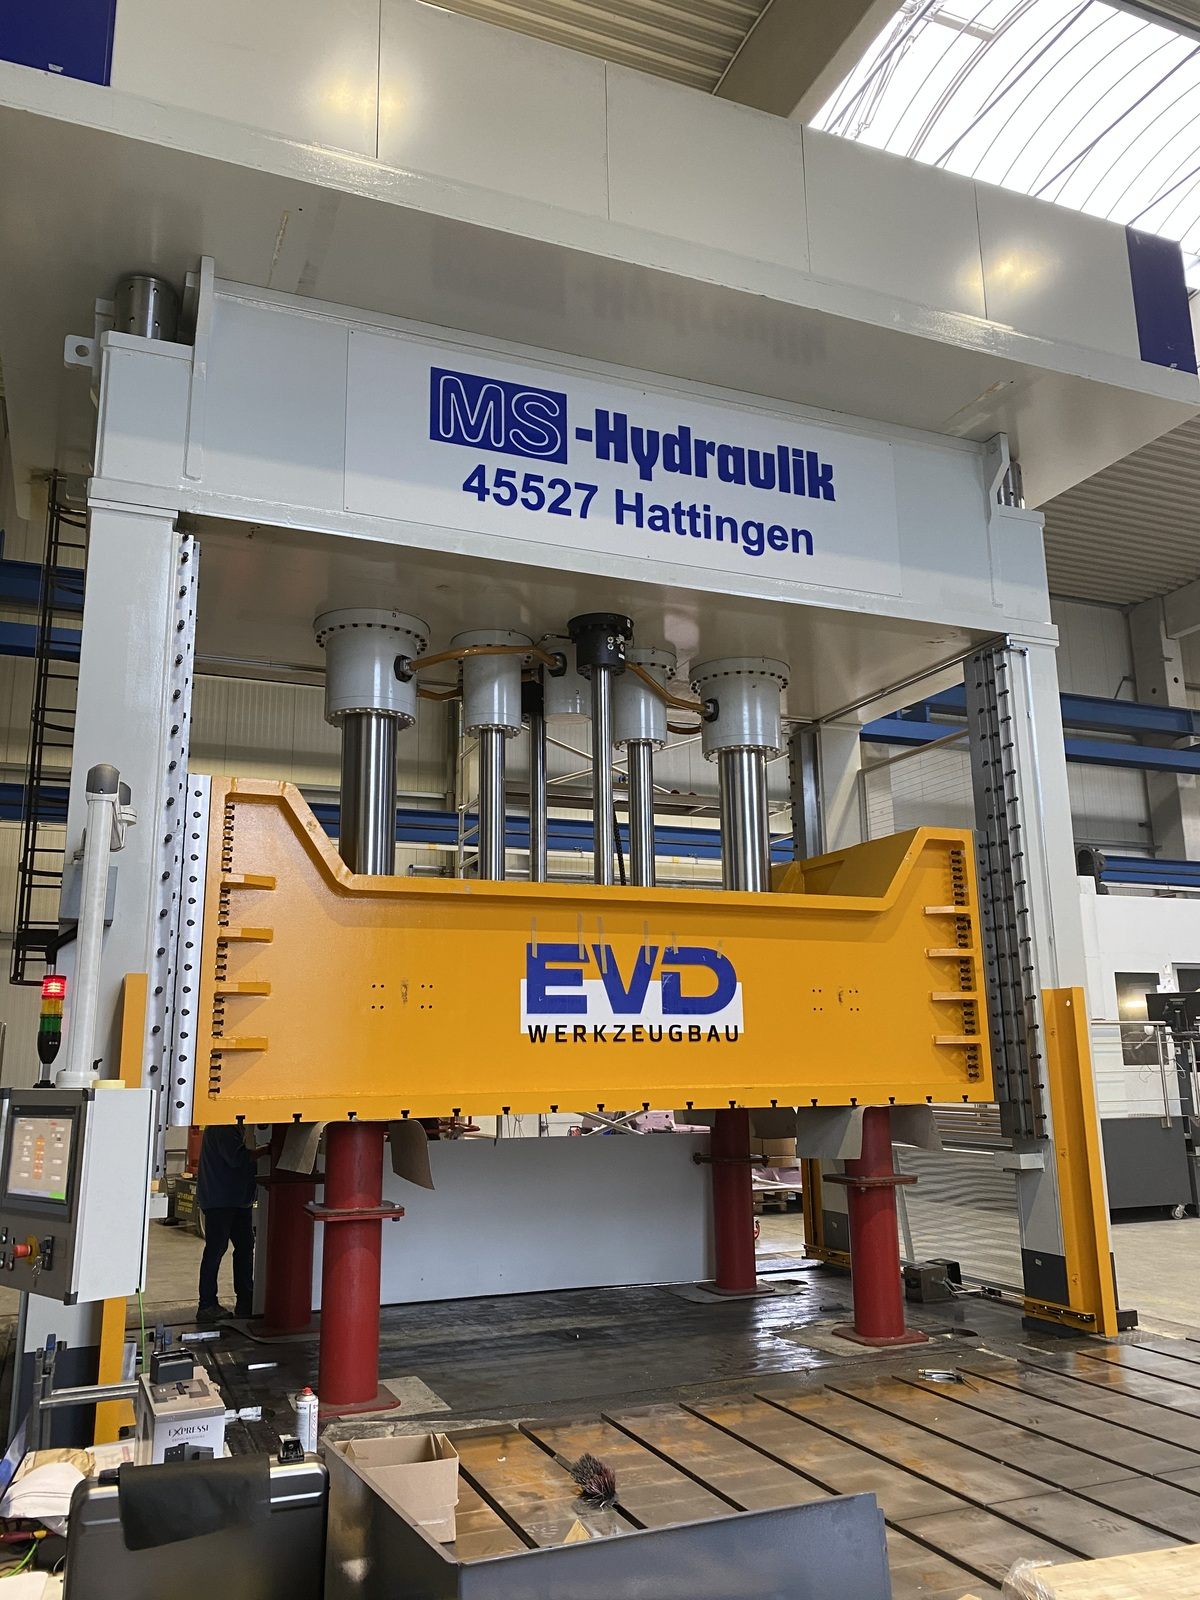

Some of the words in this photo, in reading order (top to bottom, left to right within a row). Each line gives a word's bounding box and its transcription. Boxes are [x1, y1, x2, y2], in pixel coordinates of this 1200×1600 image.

[462, 464, 598, 519] 45527
[615, 489, 814, 557] Hattingen
[526, 943, 737, 1015] EVD
[528, 1024, 739, 1043] WERKZEUGBAU
